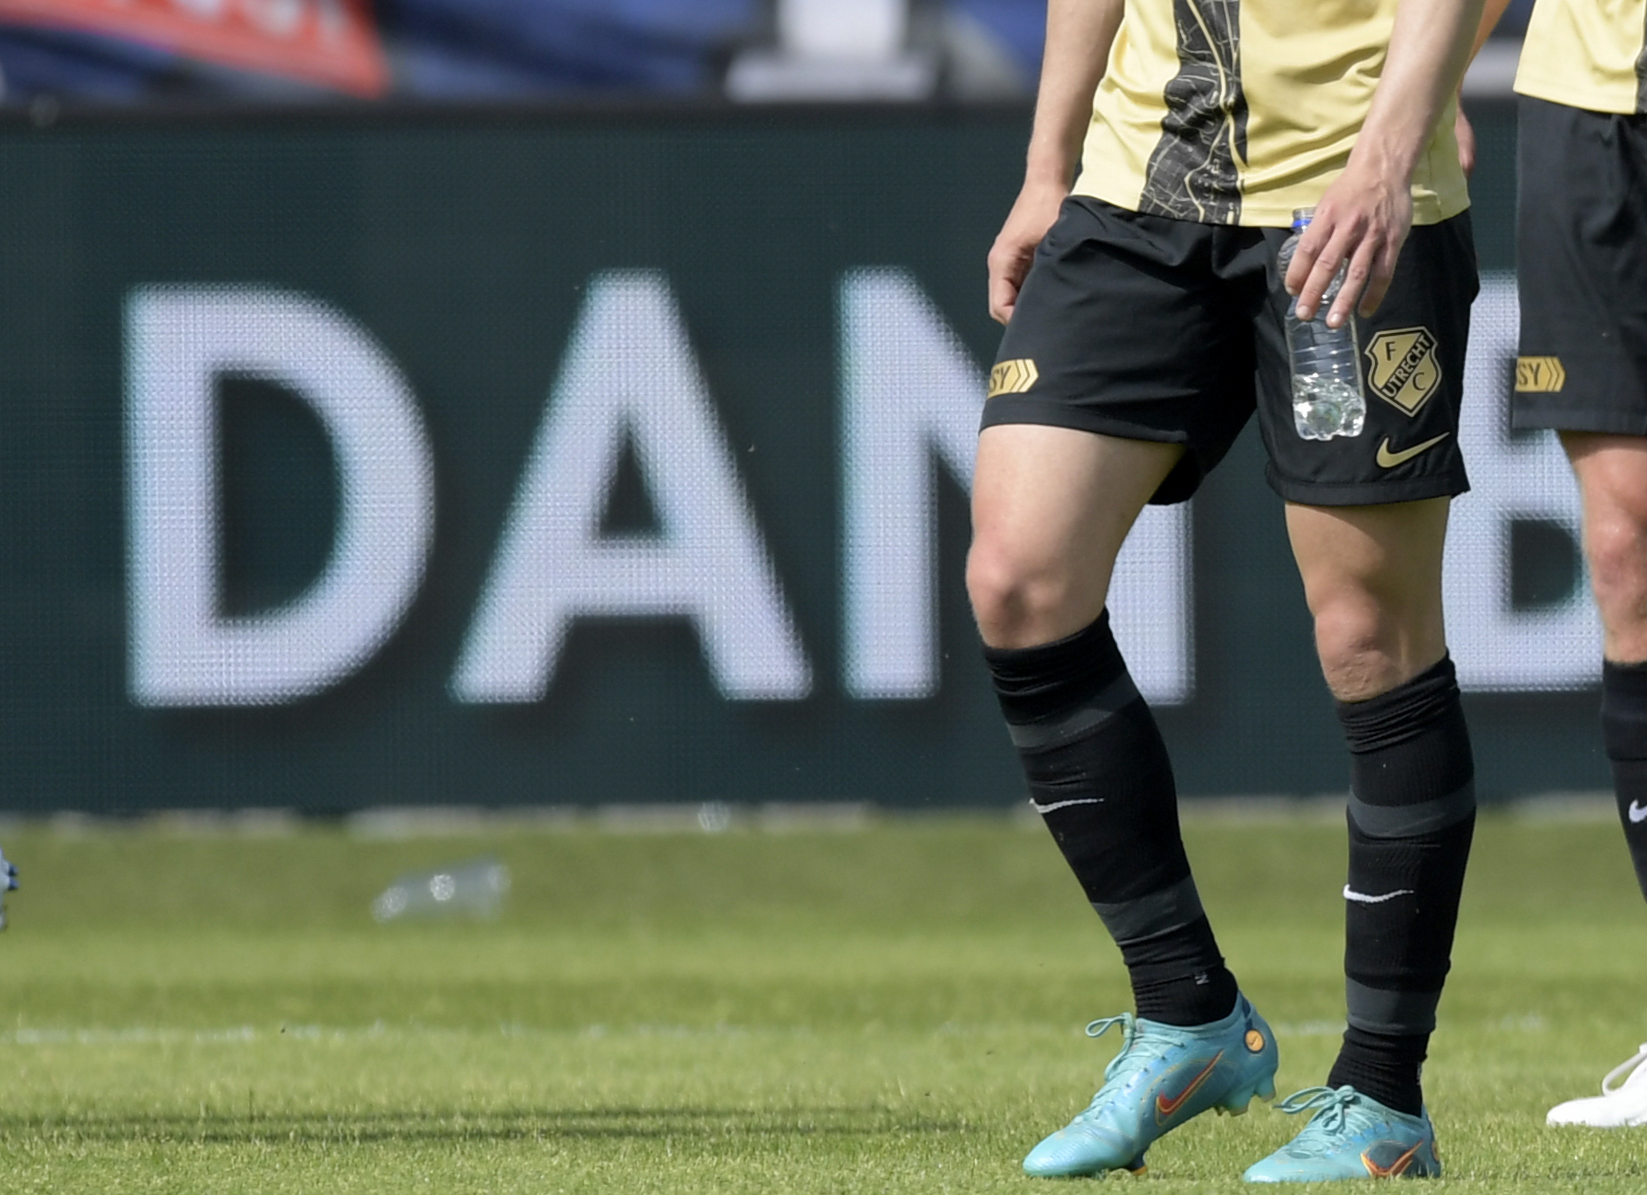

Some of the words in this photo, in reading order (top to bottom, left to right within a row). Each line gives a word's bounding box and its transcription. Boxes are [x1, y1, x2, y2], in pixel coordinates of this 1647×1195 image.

[1385, 341, 1396, 361] F
[1382, 334, 1430, 398] UTRECHT
[1412, 372, 1426, 391] C
